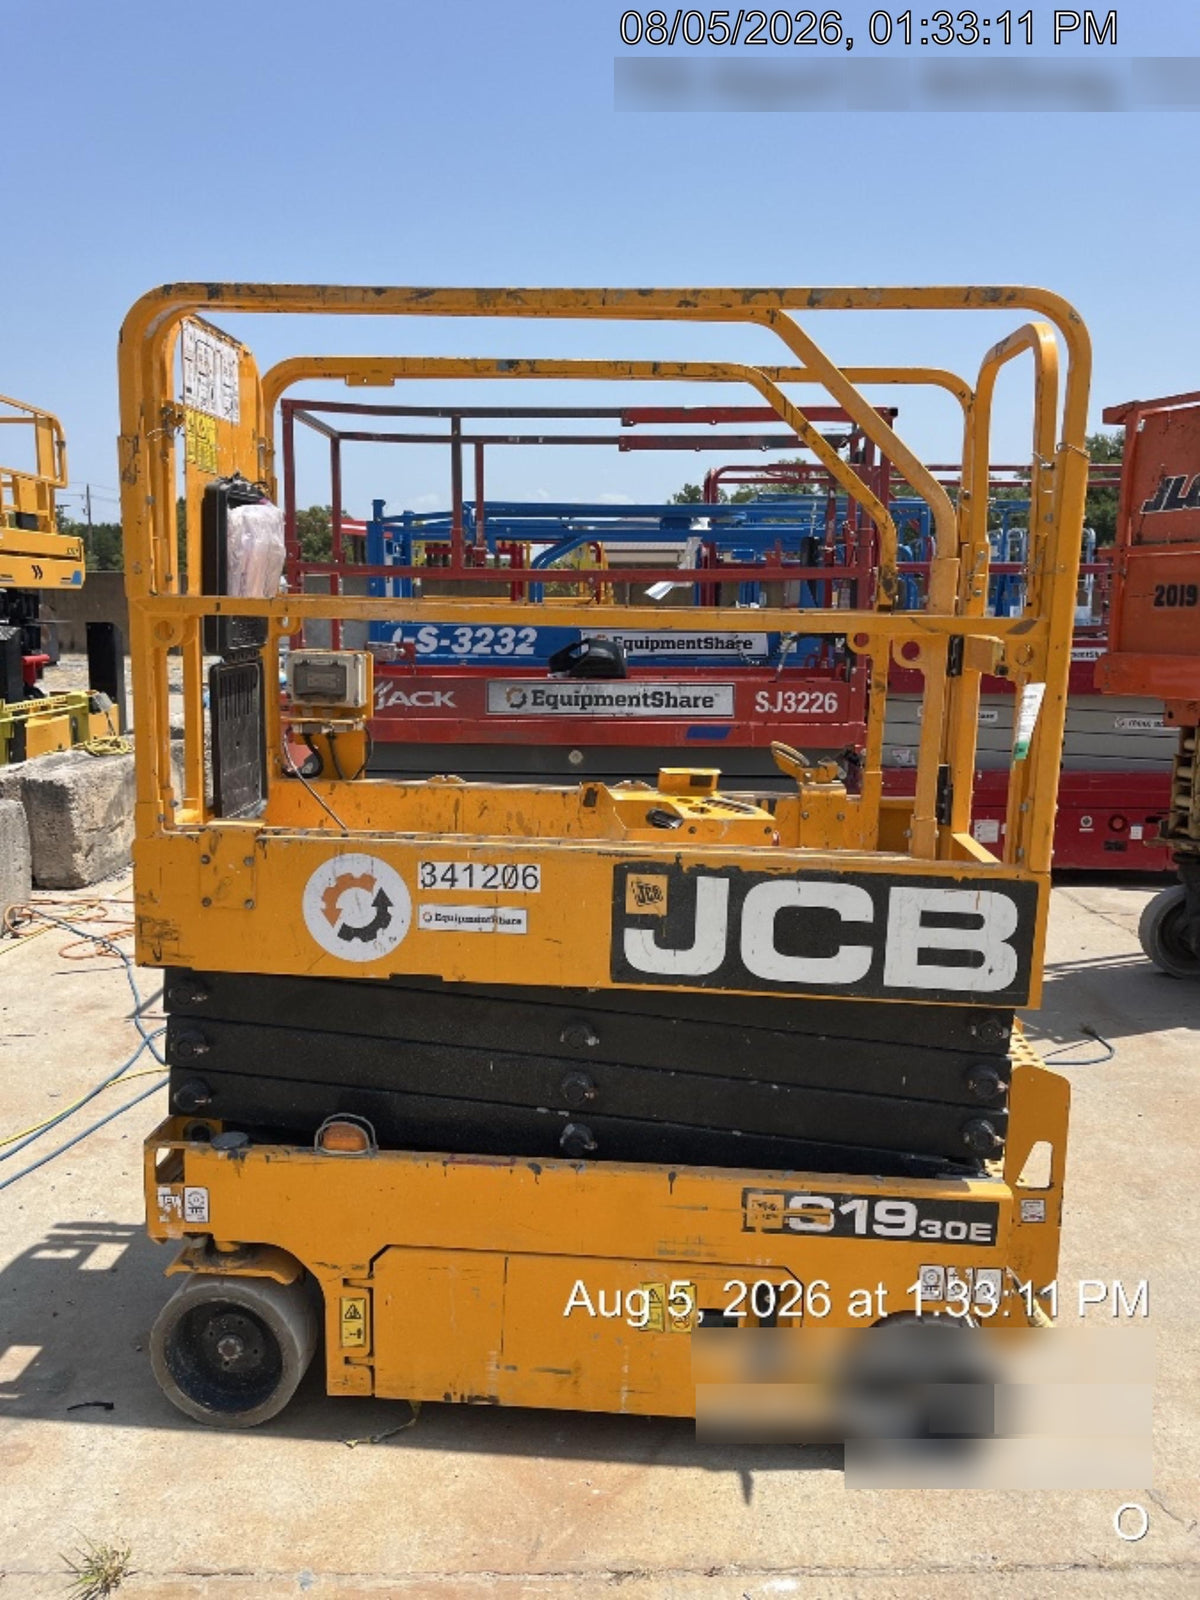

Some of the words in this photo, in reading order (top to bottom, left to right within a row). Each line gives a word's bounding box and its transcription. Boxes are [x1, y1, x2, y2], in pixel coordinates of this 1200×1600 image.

[1154, 584, 1198, 607] 2019
[531, 688, 714, 710] EquipmentShare
[755, 690, 838, 714] SJ3226
[420, 862, 540, 890] 341206
[435, 913, 522, 925] Equipmenthare
[623, 876, 1019, 992] JCB
